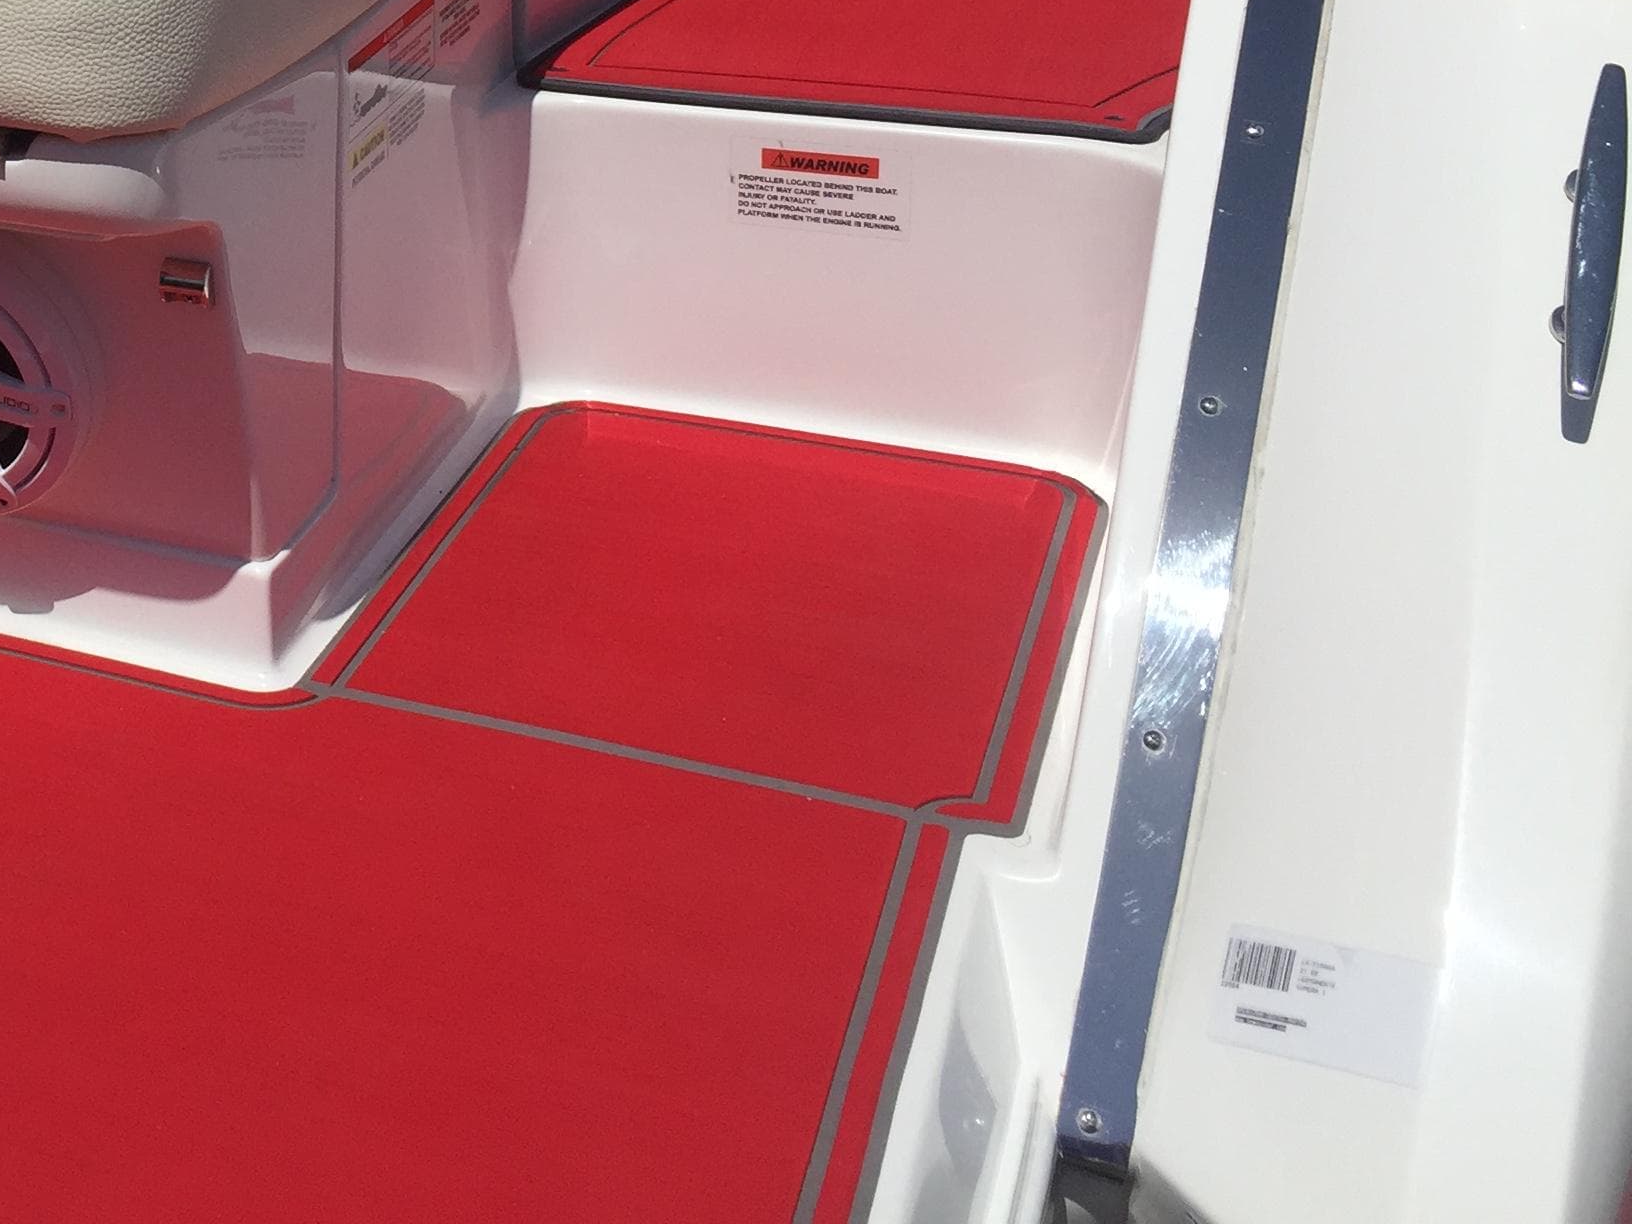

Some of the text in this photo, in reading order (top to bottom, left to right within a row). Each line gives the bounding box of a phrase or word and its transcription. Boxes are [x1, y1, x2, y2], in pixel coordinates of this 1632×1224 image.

[790, 156, 870, 175] WARNING
[738, 173, 784, 184] PROPELLER
[786, 178, 822, 188] LOCATED
[824, 182, 854, 192] BEHIND
[855, 185, 873, 193] THIS
[738, 183, 854, 200] CONTACT MAY CAUSE SEVERE
[738, 191, 765, 199] INJURY
[738, 209, 778, 218] PLATFORM
[781, 213, 803, 221] WHEN
[823, 218, 852, 226] ENGINE
[751, 201, 767, 209] NOT
[769, 204, 811, 213] APPROACH
[845, 211, 877, 219] LADDER
